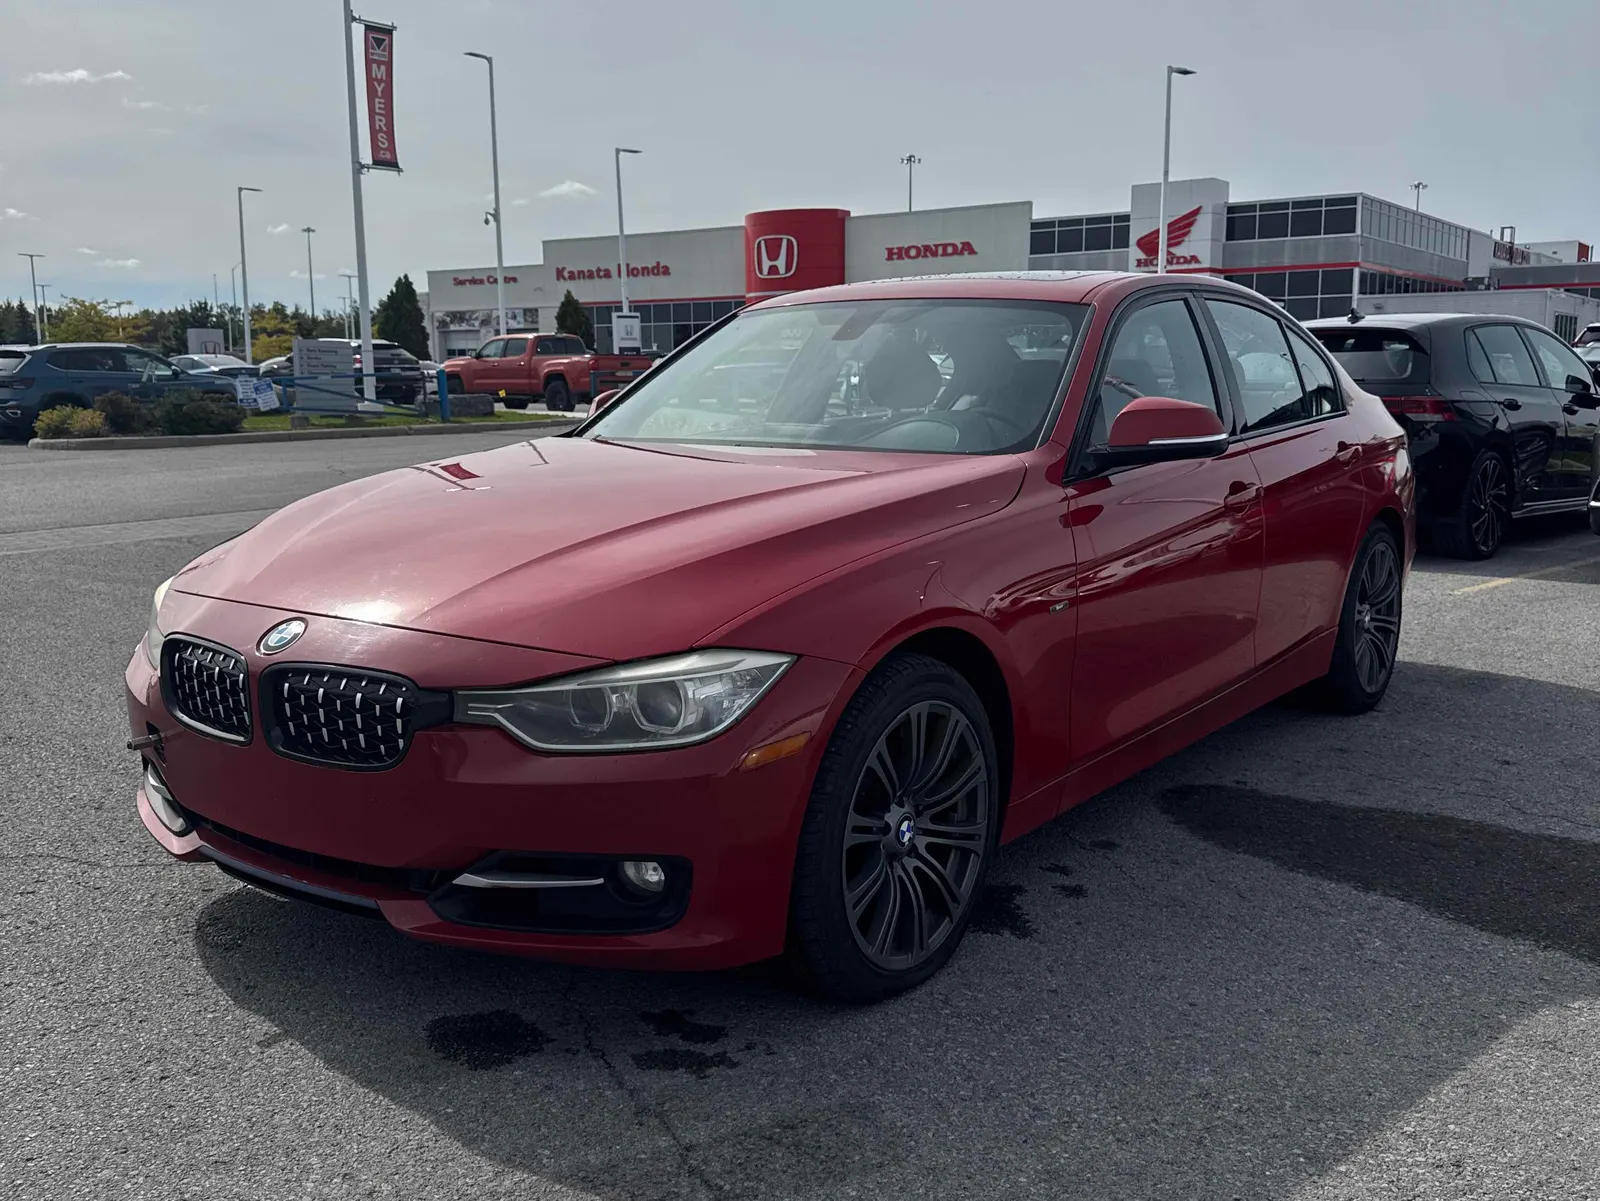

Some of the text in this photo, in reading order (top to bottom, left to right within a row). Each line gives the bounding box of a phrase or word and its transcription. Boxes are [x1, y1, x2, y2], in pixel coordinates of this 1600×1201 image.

[372, 63, 388, 148] MYERS
[885, 241, 978, 261] HONDA
[453, 275, 518, 286] Service Cetre
[556, 266, 612, 281] Kanata
